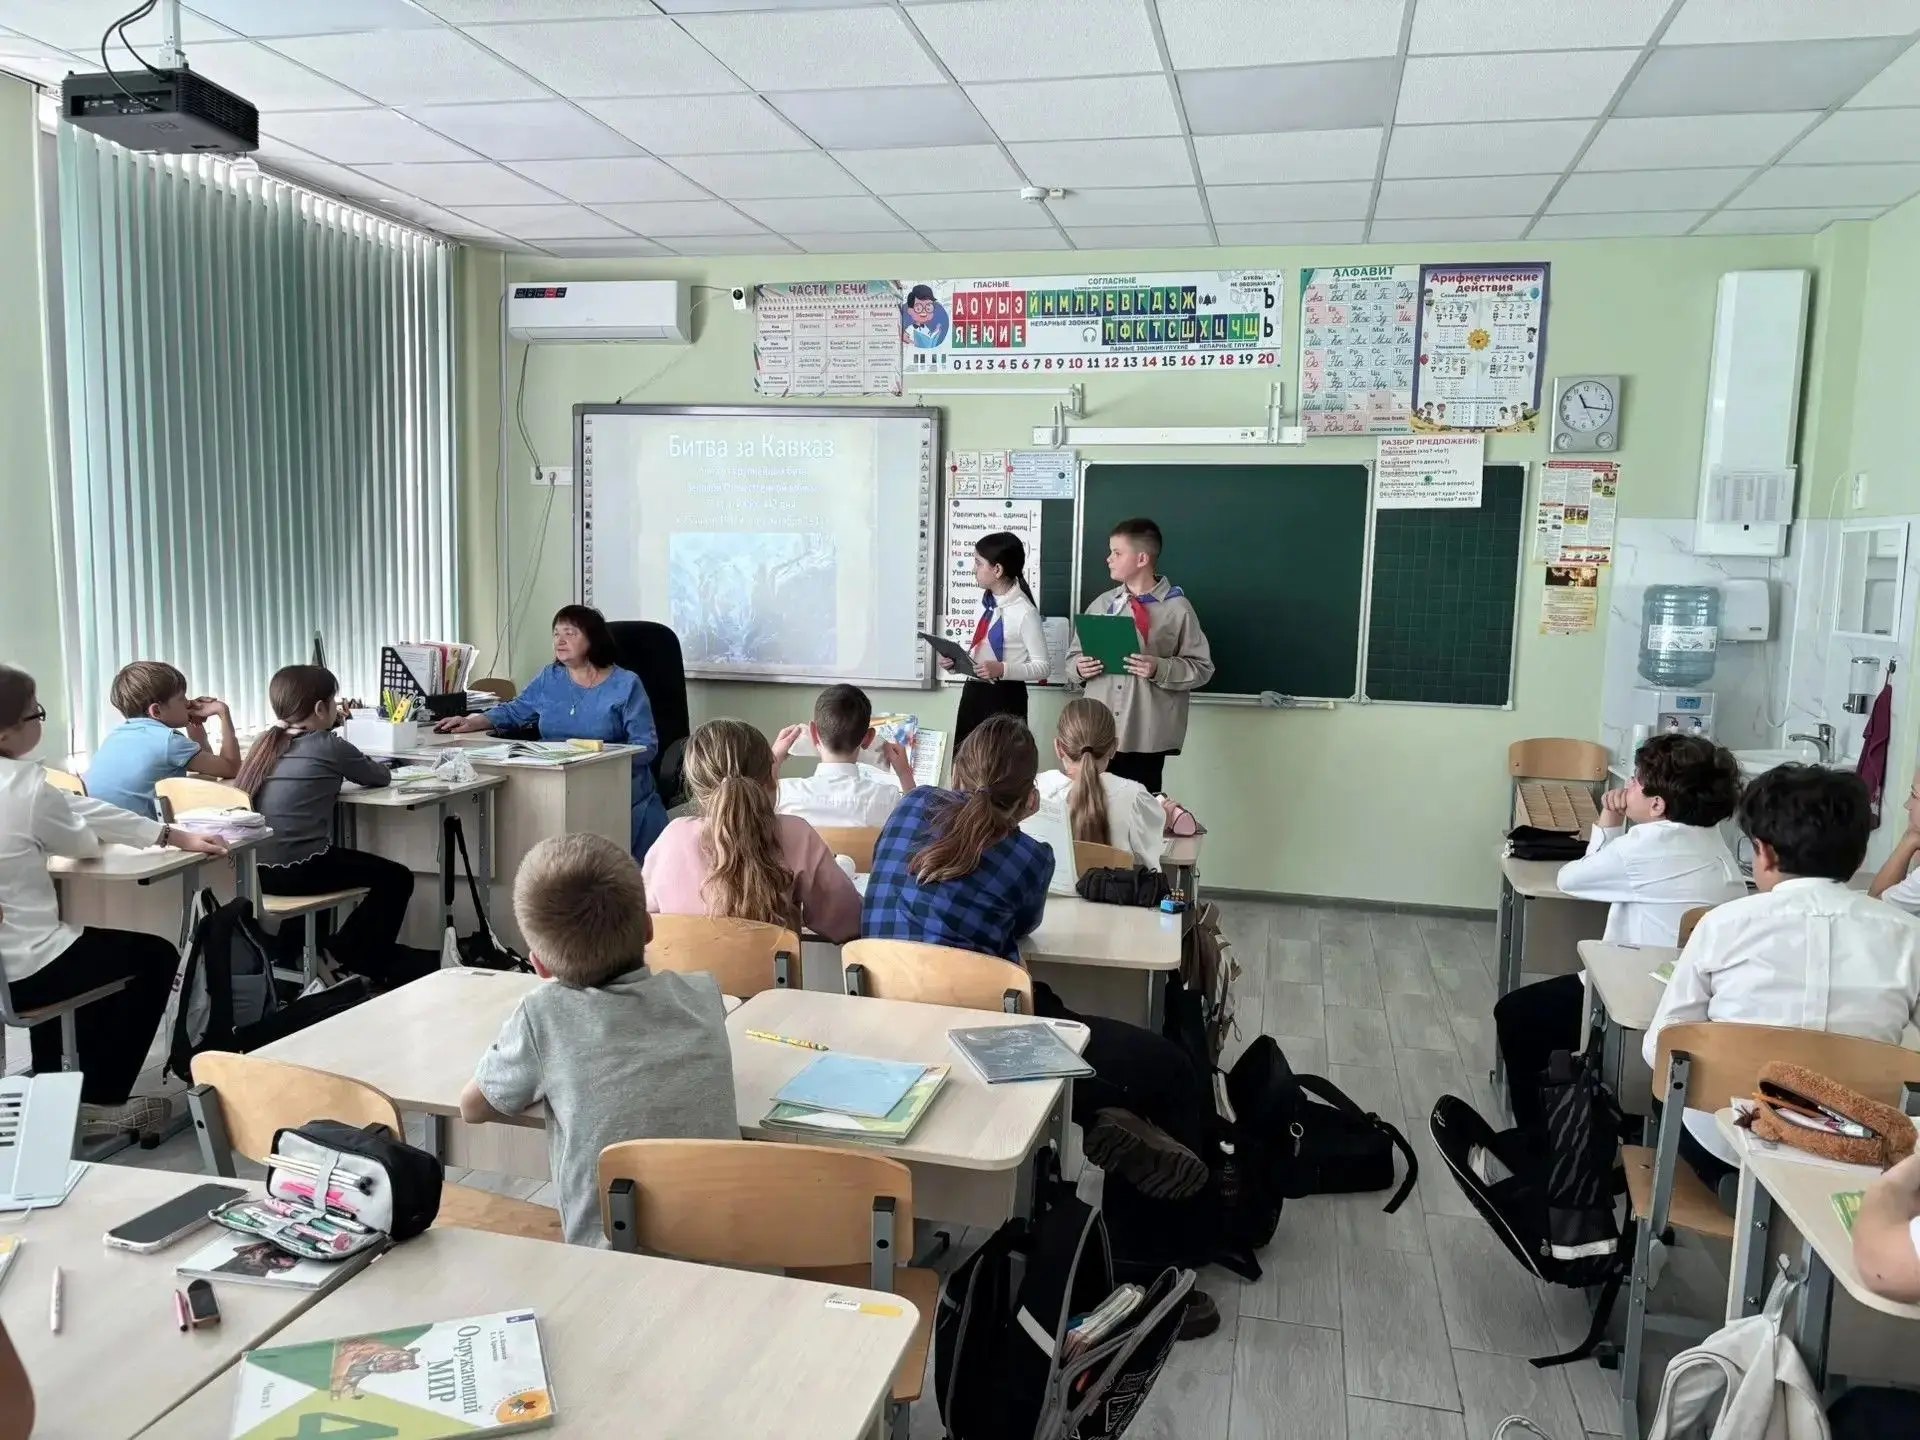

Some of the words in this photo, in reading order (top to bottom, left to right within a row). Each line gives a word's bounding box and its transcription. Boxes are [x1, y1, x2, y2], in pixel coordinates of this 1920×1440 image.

[1332, 267, 1394, 277] АЛФАВИТ
[1430, 272, 1539, 285] Арифметические
[973, 280, 1010, 289] ГЛАСНЫЕ
[1088, 277, 1136, 285] СОГЛАСНЫЕ
[1455, 281, 1513, 293] действия
[788, 283, 827, 296] ЧАСТИ
[835, 283, 866, 295] РЕЧИ
[956, 298, 964, 315] А
[970, 298, 978, 315] О
[985, 297, 994, 315] У
[998, 297, 1009, 314] Ы
[1015, 296, 1023, 313] Э
[1045, 296, 1053, 312] Н
[1060, 296, 1068, 312] М
[1076, 295, 1083, 312] Л
[1091, 294, 1098, 311] Р
[1106, 294, 1114, 311] Б
[1122, 293, 1130, 310] В
[1138, 293, 1145, 310] Г
[1152, 292, 1161, 311] Д
[1169, 292, 1176, 310] З
[1182, 291, 1195, 309] Ж
[1263, 287, 1275, 309] Ъ
[955, 327, 964, 343] Я
[970, 324, 978, 344] Ё
[983, 326, 994, 343] Ю
[1000, 326, 1007, 342] И
[1015, 325, 1022, 342] Е
[1106, 323, 1114, 340] П
[1120, 322, 1130, 340] Ф
[1136, 322, 1144, 339] К
[1152, 322, 1160, 339] Т
[1168, 321, 1176, 338] С
[1181, 321, 1194, 338] Ш
[1200, 320, 1208, 337] Х
[1216, 319, 1224, 338] Ц
[1232, 320, 1240, 336] Ч
[1245, 317, 1258, 339] Щ
[1263, 316, 1273, 338] Ь
[953, 360, 961, 369] 0
[965, 360, 971, 369] 1
[975, 360, 983, 369] 2
[987, 360, 994, 369] 3
[998, 360, 1006, 369] 4
[1010, 359, 1017, 369] 5
[1022, 359, 1029, 369] 6
[1034, 359, 1041, 368] 7
[1045, 358, 1052, 368] 8
[1057, 358, 1064, 368] 9
[1069, 358, 1082, 368] 10
[1087, 358, 1099, 368] 11
[1104, 357, 1119, 368] 12
[1123, 357, 1138, 367] 13
[1142, 356, 1157, 367] 14
[1162, 356, 1176, 366] 15
[1181, 355, 1196, 366] 16
[1200, 355, 1214, 365] 17
[1219, 354, 1234, 365] 18
[1238, 354, 1253, 364] 19
[1258, 353, 1274, 364] 20
[669, 434, 728, 457] Битва
[735, 440, 754, 457] за
[762, 433, 834, 457] Кавказ
[946, 619, 975, 627] УРАВ
[454, 1325, 483, 1414] Окружающий
